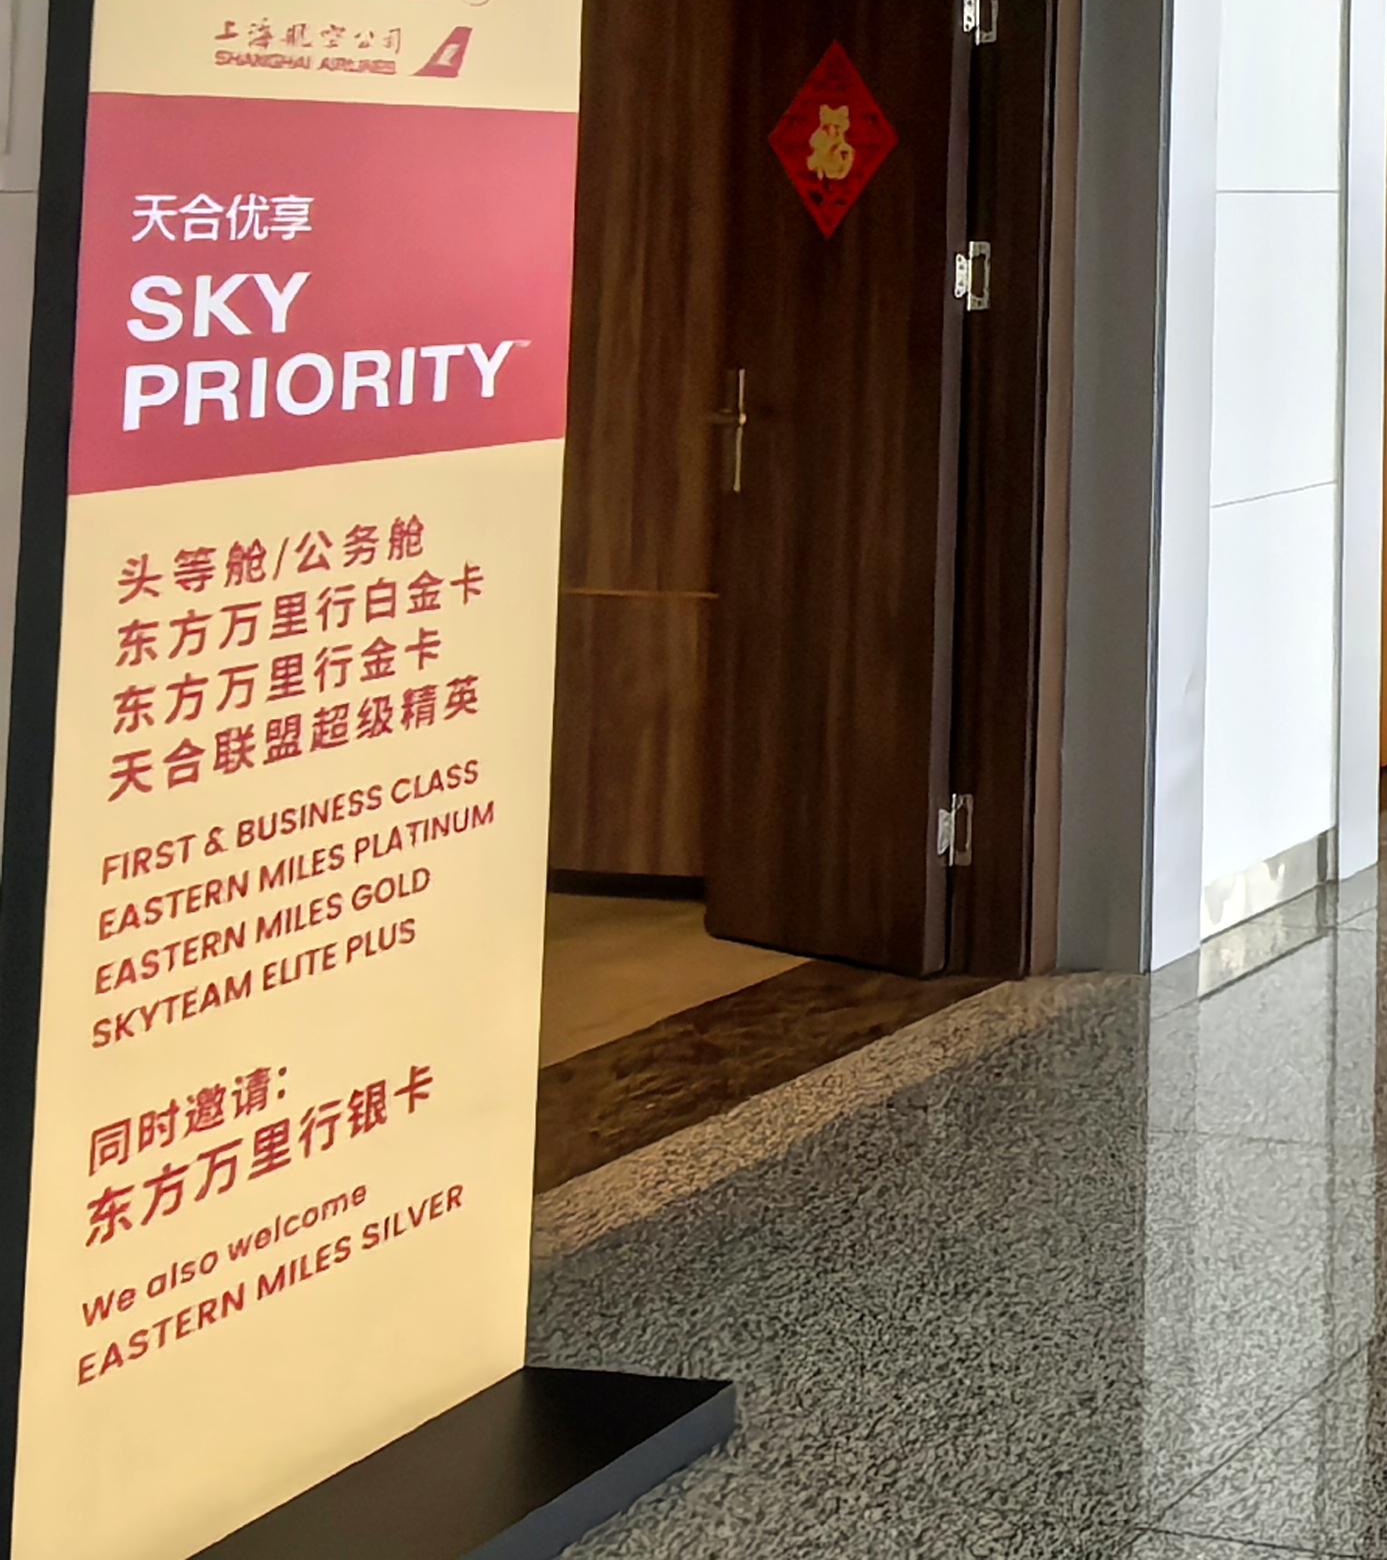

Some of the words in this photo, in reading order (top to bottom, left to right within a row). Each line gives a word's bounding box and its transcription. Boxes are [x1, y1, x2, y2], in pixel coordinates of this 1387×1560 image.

[214, 50, 312, 71] SHANGHAI
[319, 56, 397, 75] AIRLINES
[131, 192, 315, 243] 天合优享
[126, 271, 312, 342] SKY
[122, 340, 516, 432] PRIORITY
[114, 562, 486, 667] 东方万里行白金卡
[117, 514, 426, 605] 头等舱/公务舱
[107, 674, 481, 803] 天合联盟超级精英
[112, 626, 443, 735] 东方万里行金卡
[98, 870, 250, 941] EASTERN
[258, 843, 346, 894] MILES
[353, 801, 496, 866] PLATINUM
[101, 832, 198, 886] FIRST
[203, 826, 227, 854] &
[236, 784, 384, 848] BUSINESS
[390, 759, 481, 805] CLASS
[91, 969, 252, 1049] SKYTEAM
[262, 935, 338, 991] ELITE
[345, 918, 418, 965] PLUS
[94, 926, 247, 996] EASTERN
[254, 892, 343, 948] MILES
[351, 866, 432, 912] GOLD
[85, 1064, 435, 1247] 东方万里行银卡
[77, 1281, 246, 1387] EASTERN
[256, 1235, 354, 1302] MILES
[360, 1183, 466, 1251] SILVER
[81, 1282, 137, 1328] We
[145, 1247, 219, 1300] also
[227, 1183, 369, 1264] welcome
